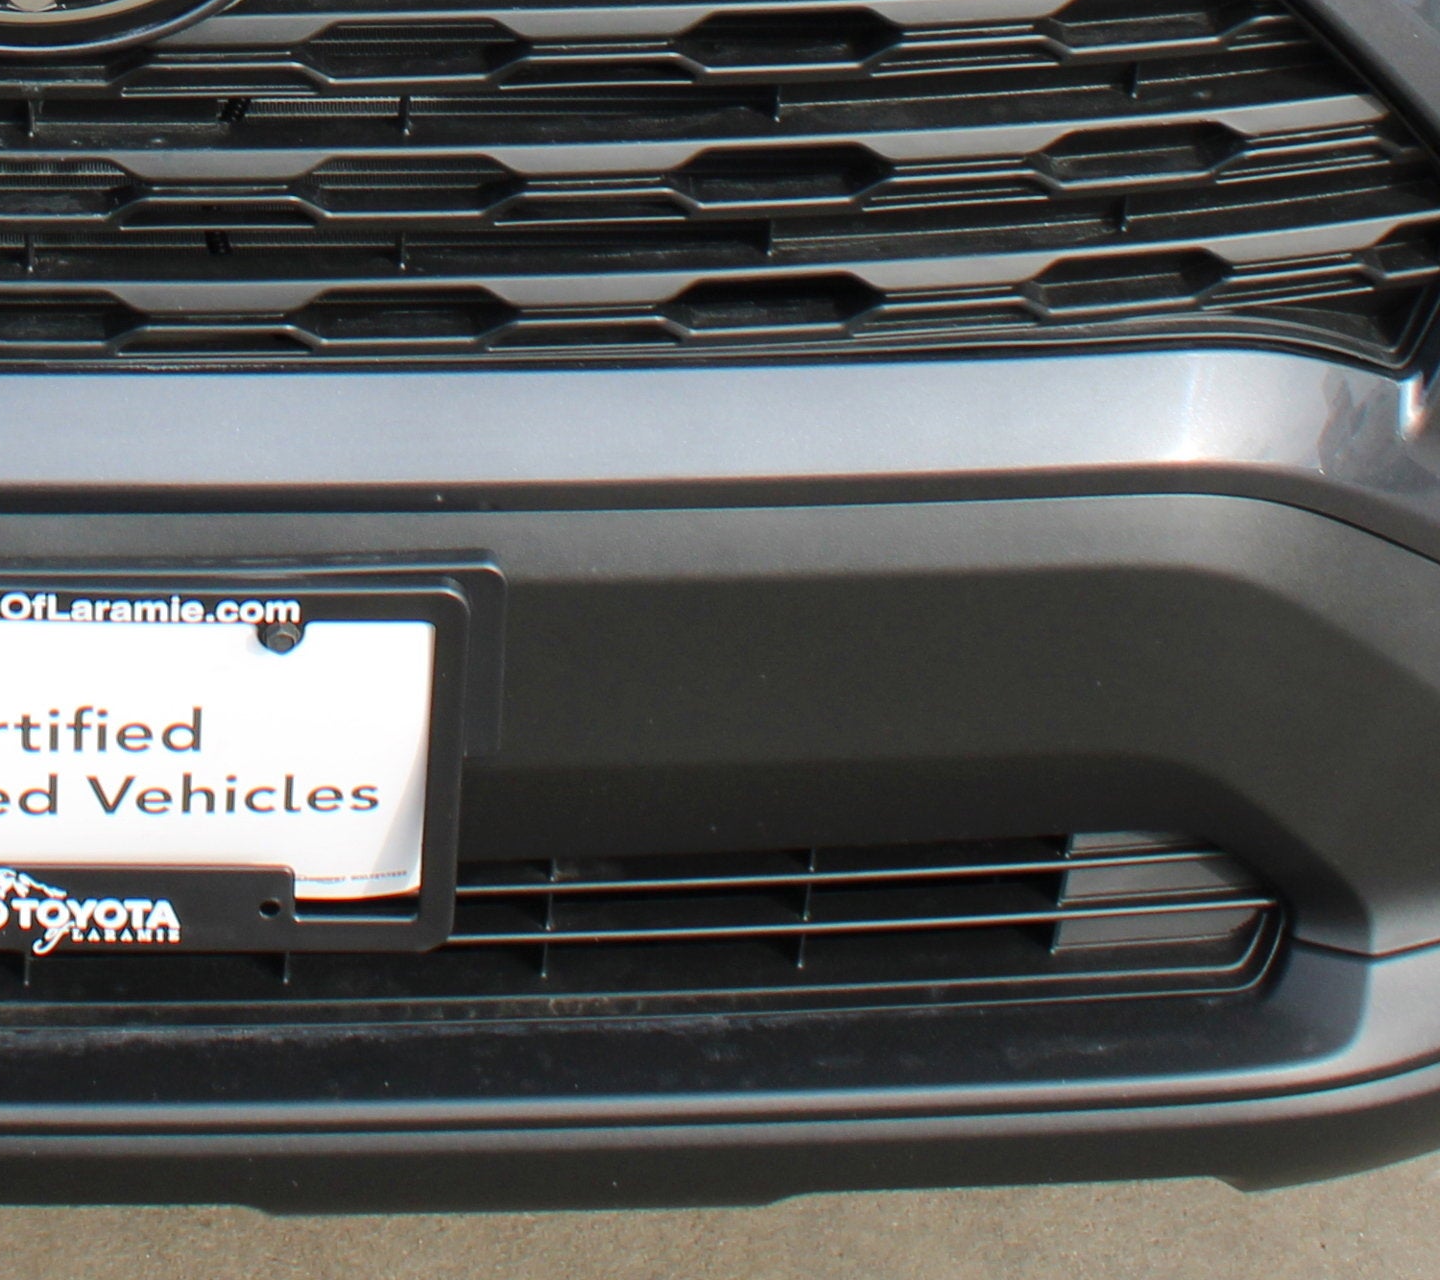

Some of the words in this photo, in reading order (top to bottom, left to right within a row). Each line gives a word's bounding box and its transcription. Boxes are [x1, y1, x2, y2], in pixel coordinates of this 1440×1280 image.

[86, 772, 381, 816] Vehicles
[11, 897, 181, 929] TOYOTA
[71, 927, 181, 943] LARAMIE
